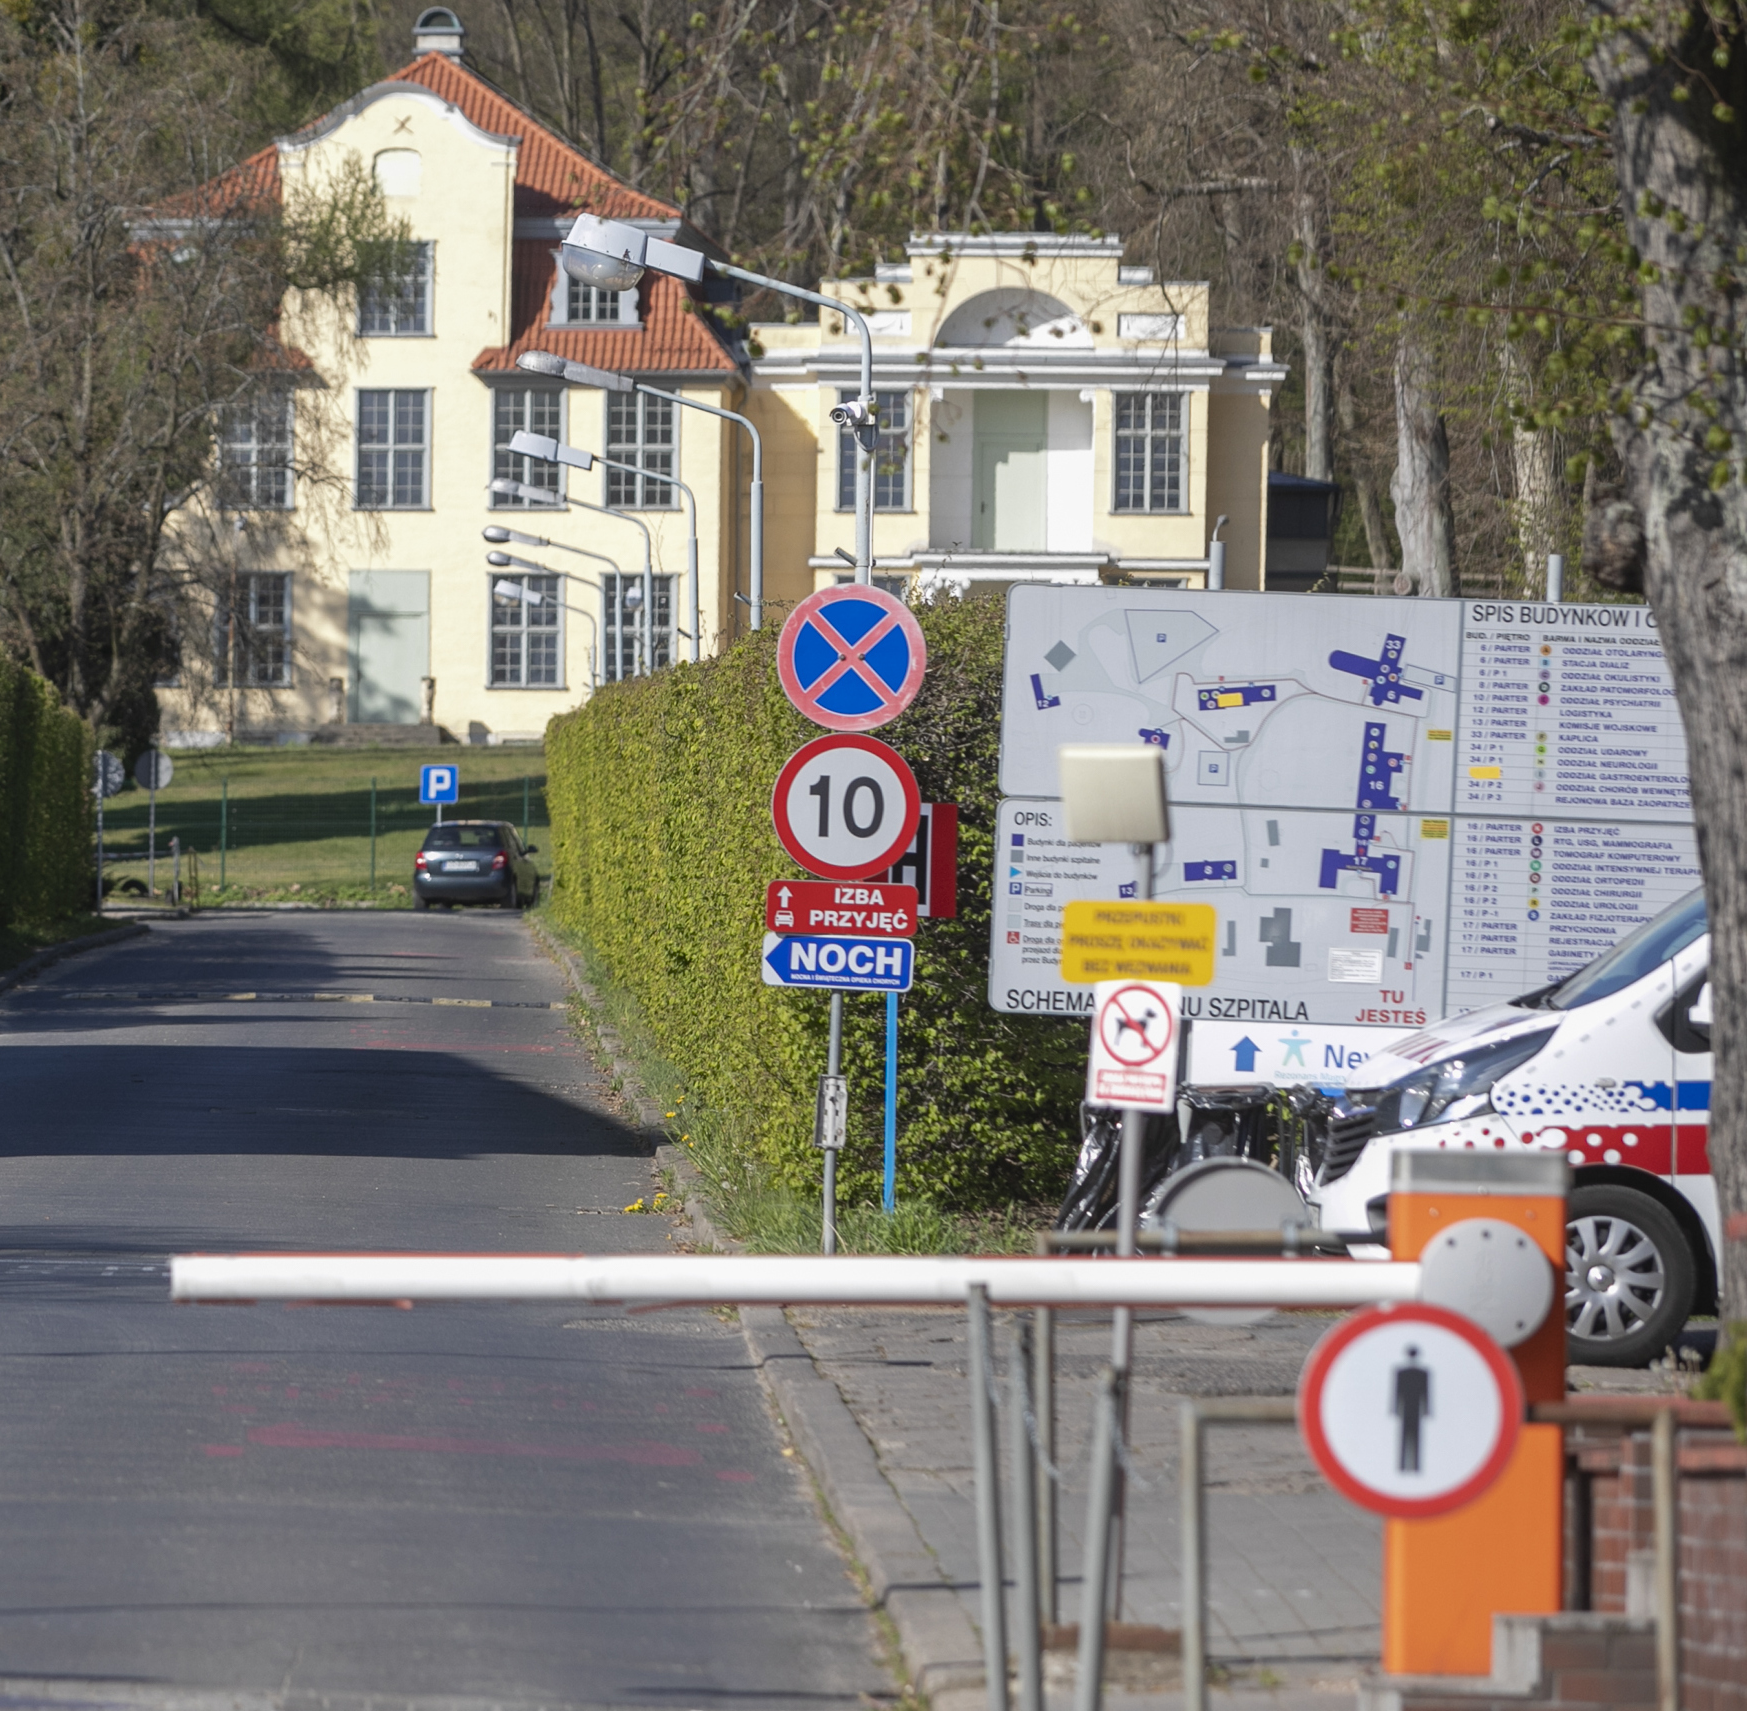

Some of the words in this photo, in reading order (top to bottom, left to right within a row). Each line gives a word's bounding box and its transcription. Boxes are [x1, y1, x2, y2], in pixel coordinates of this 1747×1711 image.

[1472, 604, 1514, 623] SPIS
[1385, 640, 1401, 650] 33
[1619, 637, 1661, 646] ODDZIAŁ
[1605, 649, 1666, 658] OTOLARYNG
[1387, 690, 1396, 700] 6
[1600, 686, 1677, 696] PATOMORFOLOG
[1037, 700, 1049, 708] 12
[1599, 773, 1690, 784] GASTROENTEROLO
[428, 768, 452, 800] P
[1369, 781, 1384, 790] 16
[1641, 787, 1691, 796] WEWNĘTR
[809, 775, 884, 838] 10
[1637, 799, 1691, 808] ZAOPATRZE
[1014, 811, 1052, 827] OPIS:
[1354, 857, 1368, 865] 17
[1204, 865, 1213, 875] 8
[1121, 886, 1133, 894] 13
[834, 887, 884, 906] IZBA
[809, 908, 908, 932] PRZYJĘĆ
[790, 941, 903, 976] NOCH
[1379, 989, 1404, 1004] TU
[1006, 989, 1095, 1012] SCHEMA
[1209, 998, 1309, 1020] SZPITALA
[1355, 1007, 1427, 1025] JESTEŚ
